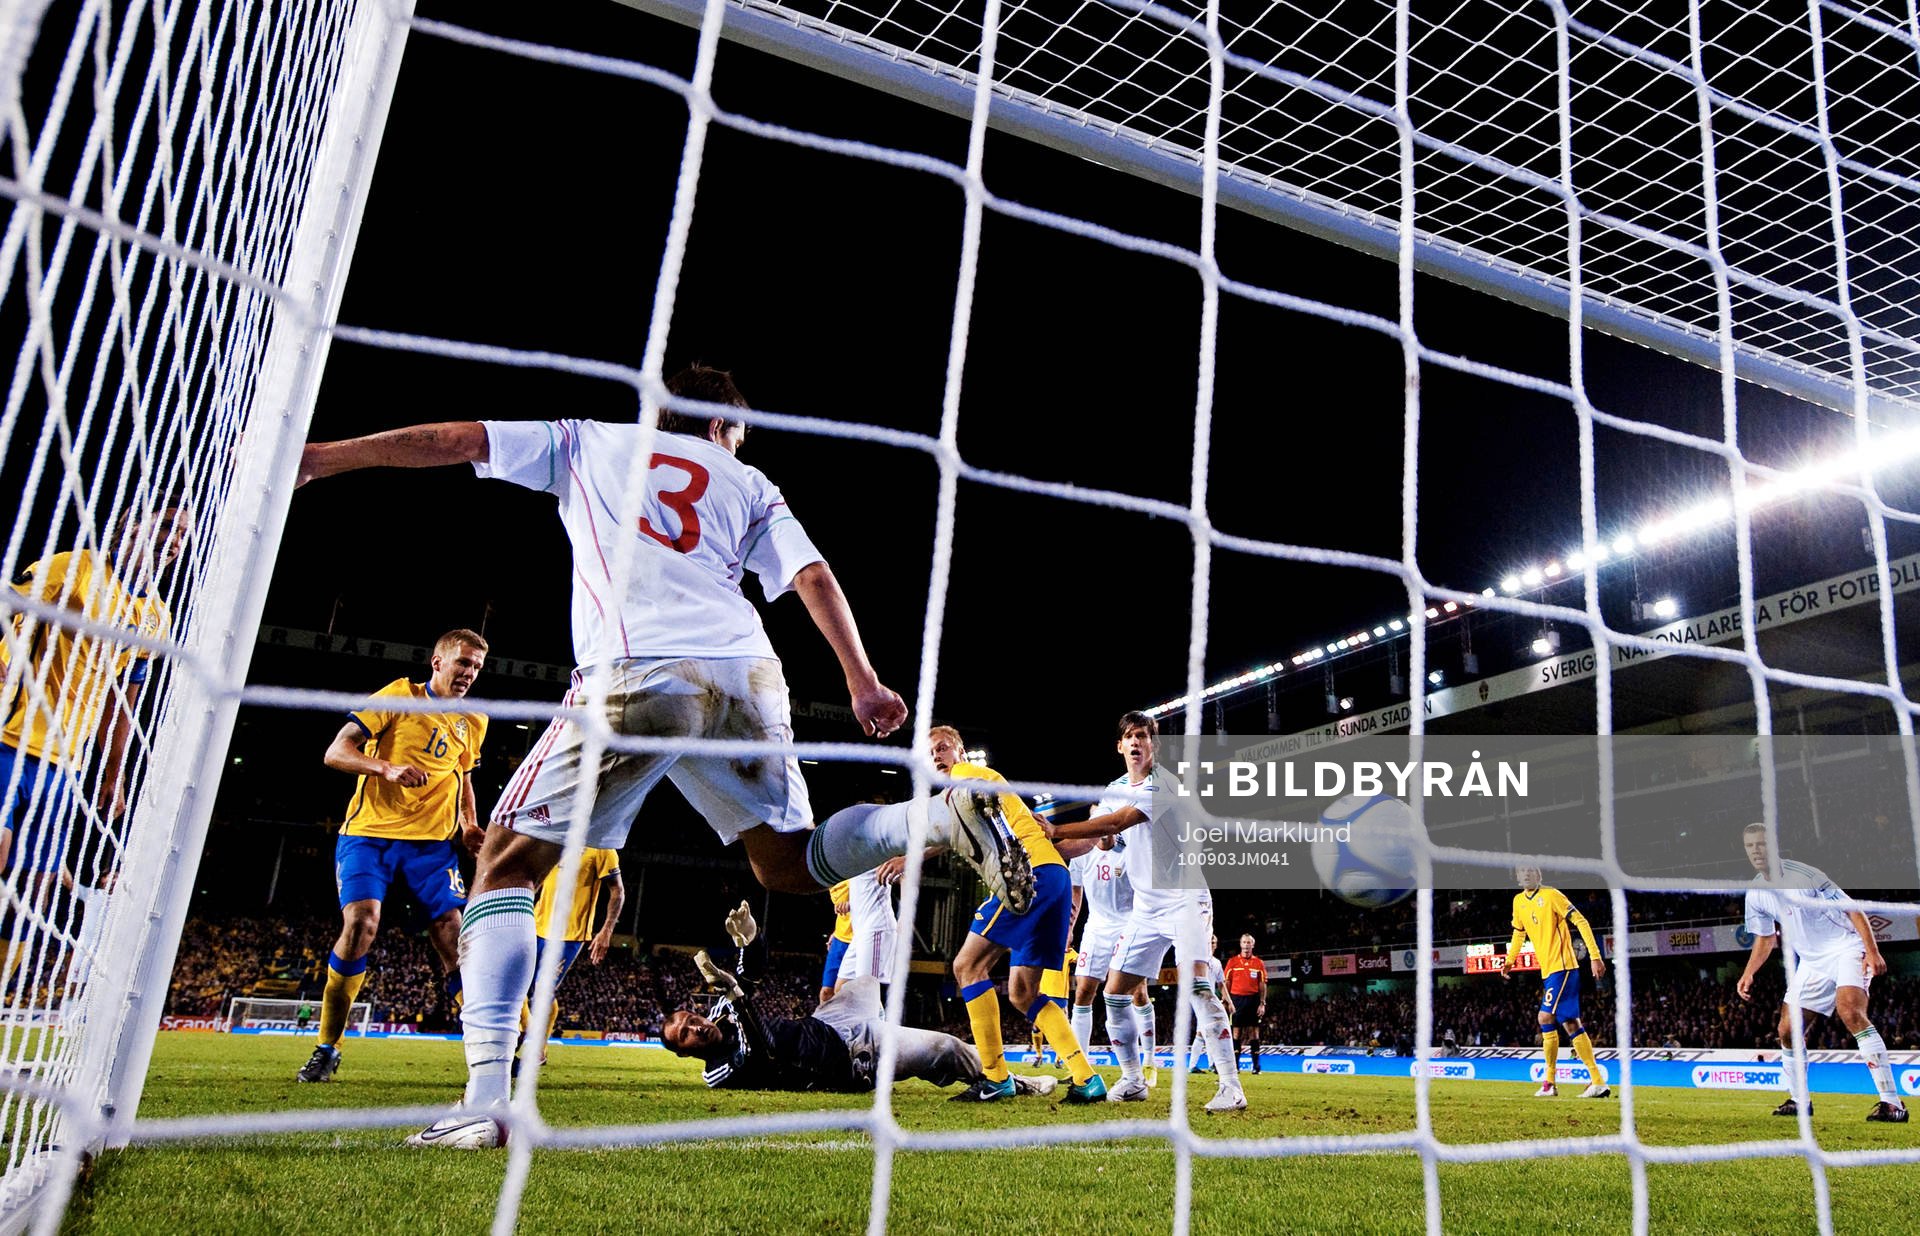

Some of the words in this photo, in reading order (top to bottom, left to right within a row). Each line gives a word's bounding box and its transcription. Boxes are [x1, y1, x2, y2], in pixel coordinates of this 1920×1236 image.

[637, 451, 710, 555] 3
[1542, 654, 1598, 683] SVERIG
[1779, 590, 1820, 618] FÖR
[423, 727, 448, 759] 16
[1241, 737, 1300, 762] VÄLKOMMEN
[1305, 731, 1321, 747] TILL
[1325, 716, 1377, 742] RÅSUNDA
[1382, 700, 1432, 727] STADN
[446, 867, 466, 895] 16
[1096, 864, 1111, 881] 18
[1358, 955, 1389, 969] Scandic
[1544, 986, 1554, 1003] 6
[1710, 1071, 1781, 1085] INTERSPORT
